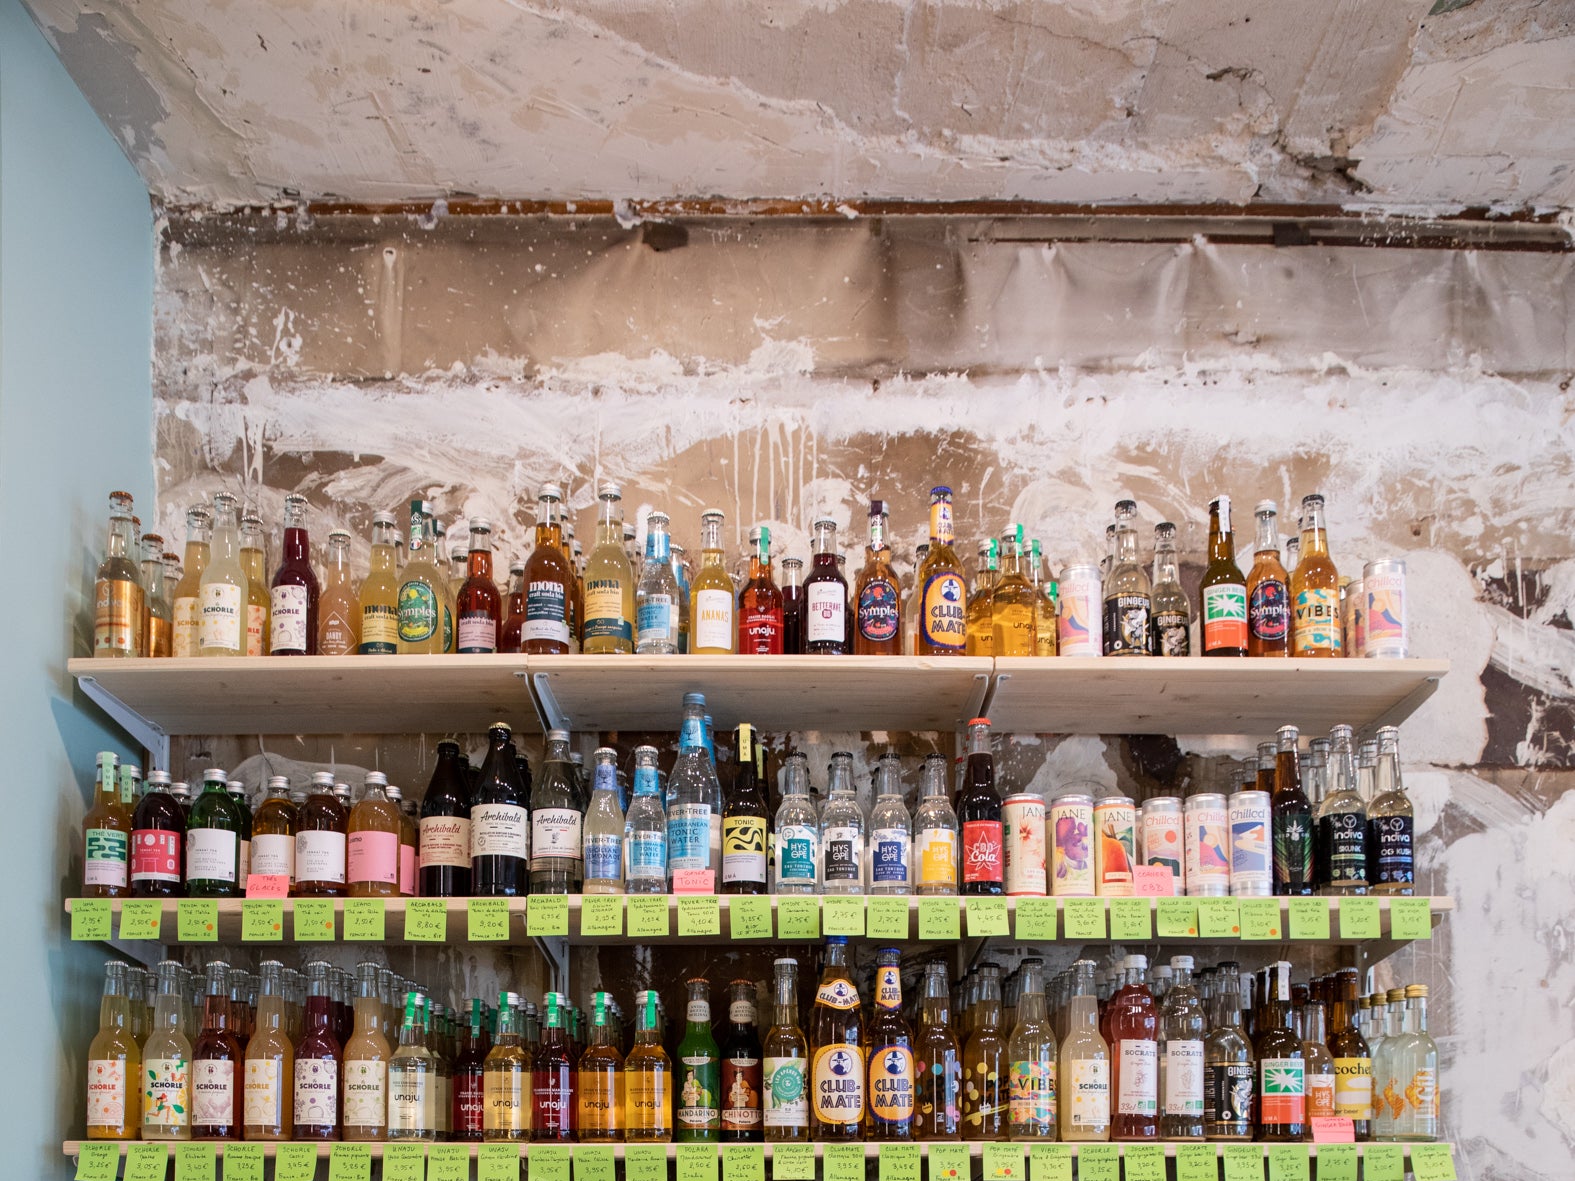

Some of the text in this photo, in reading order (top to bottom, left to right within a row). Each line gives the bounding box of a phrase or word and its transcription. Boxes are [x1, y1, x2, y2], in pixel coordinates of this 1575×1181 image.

[529, 581, 564, 592] mona
[586, 580, 619, 589] mona
[203, 607, 234, 615] SCHORLE
[271, 608, 300, 616] SCHORLE
[859, 605, 898, 620] Symples
[1250, 605, 1291, 617] Symples
[1296, 605, 1339, 620] VIBES
[701, 610, 729, 624] ANANAS
[749, 626, 776, 636] unaju
[931, 620, 966, 634] MATE
[480, 810, 522, 826] Archibald
[536, 811, 577, 826] Archibald
[1103, 811, 1131, 823] JANE
[1231, 809, 1265, 820] Chilled
[422, 823, 461, 835] Archibald
[671, 827, 698, 836] TONIC
[671, 835, 700, 845] WATER
[1333, 830, 1363, 840] indiva
[1380, 834, 1411, 843] indiva
[1338, 845, 1361, 853] SKUNK
[970, 851, 996, 862] Cola
[677, 876, 709, 886] TONIC
[880, 993, 900, 1001] MATE
[1124, 1048, 1156, 1057] SOCRATE
[1079, 1082, 1107, 1090] SCHORLE
[394, 1092, 420, 1103] unaju
[820, 1095, 861, 1109] MATE
[875, 1094, 913, 1108] MATE
[492, 1099, 519, 1109] unaju
[539, 1100, 566, 1110] unaju
[584, 1100, 610, 1110] unaju
[634, 1100, 660, 1110] unaju
[677, 1109, 716, 1118] MANDARINO
